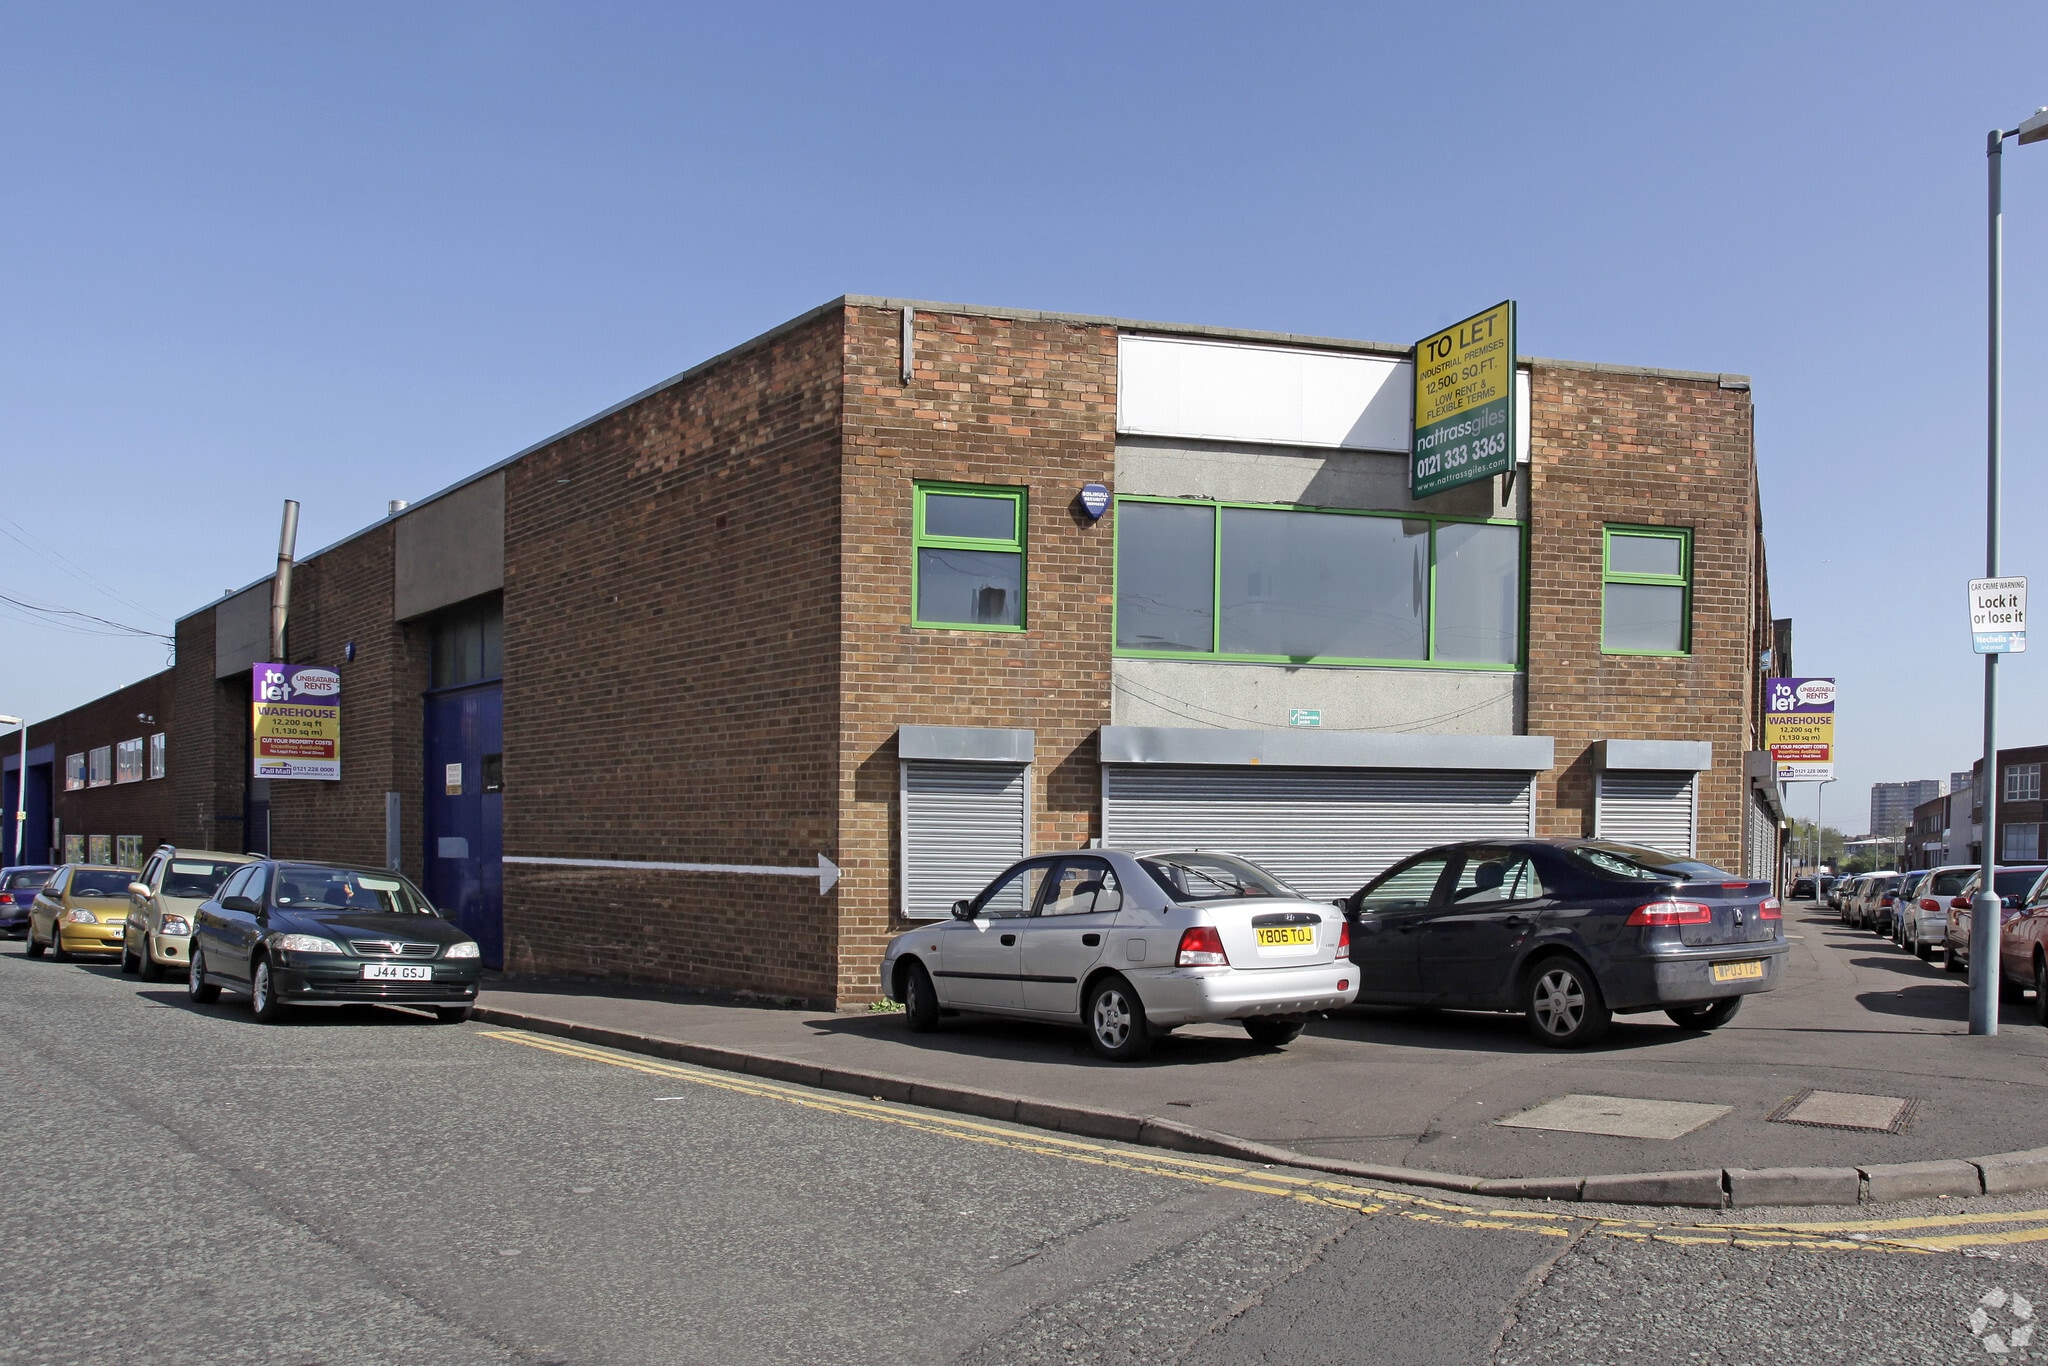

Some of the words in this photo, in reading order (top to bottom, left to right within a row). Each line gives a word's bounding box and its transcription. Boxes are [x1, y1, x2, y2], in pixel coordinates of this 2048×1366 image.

[1426, 334, 1452, 362] TO
[1460, 314, 1498, 349] LET
[1420, 356, 1462, 380] INDUSTRIAL
[1464, 338, 1504, 362] PREMISES
[1426, 372, 1458, 395] 12,500
[1462, 357, 1498, 380] SQ.FT.
[1435, 392, 1452, 406] LOW
[1456, 382, 1478, 398] RENT
[1480, 379, 1486, 388] &
[1427, 398, 1463, 420] FLEXIBLE
[1466, 386, 1496, 404] TERMS
[1417, 408, 1506, 452] nattrassgiles
[1417, 454, 1440, 478] 0121
[1444, 444, 1468, 469] 333
[1472, 432, 1506, 460] 3363
[1417, 458, 1506, 491] www.nattrassgiles.com
[2000, 581, 2024, 589] WARNING
[1978, 594, 2006, 608] Lock
[2009, 594, 2017, 607] it
[1974, 614, 1985, 624] or
[1988, 610, 2012, 623] lose
[2015, 609, 2023, 622] it
[1976, 635, 2006, 643] Nechells
[265, 670, 285, 684] to
[296, 675, 340, 684] UNBEATABLE
[261, 680, 292, 700] let
[1776, 684, 1791, 696] to
[1772, 694, 1796, 711] let
[258, 707, 336, 718] WAREHOUSE
[1258, 930, 1288, 943] Y806
[1291, 928, 1312, 942] TOJ
[374, 967, 397, 977] J44
[402, 968, 425, 978] GSJ
